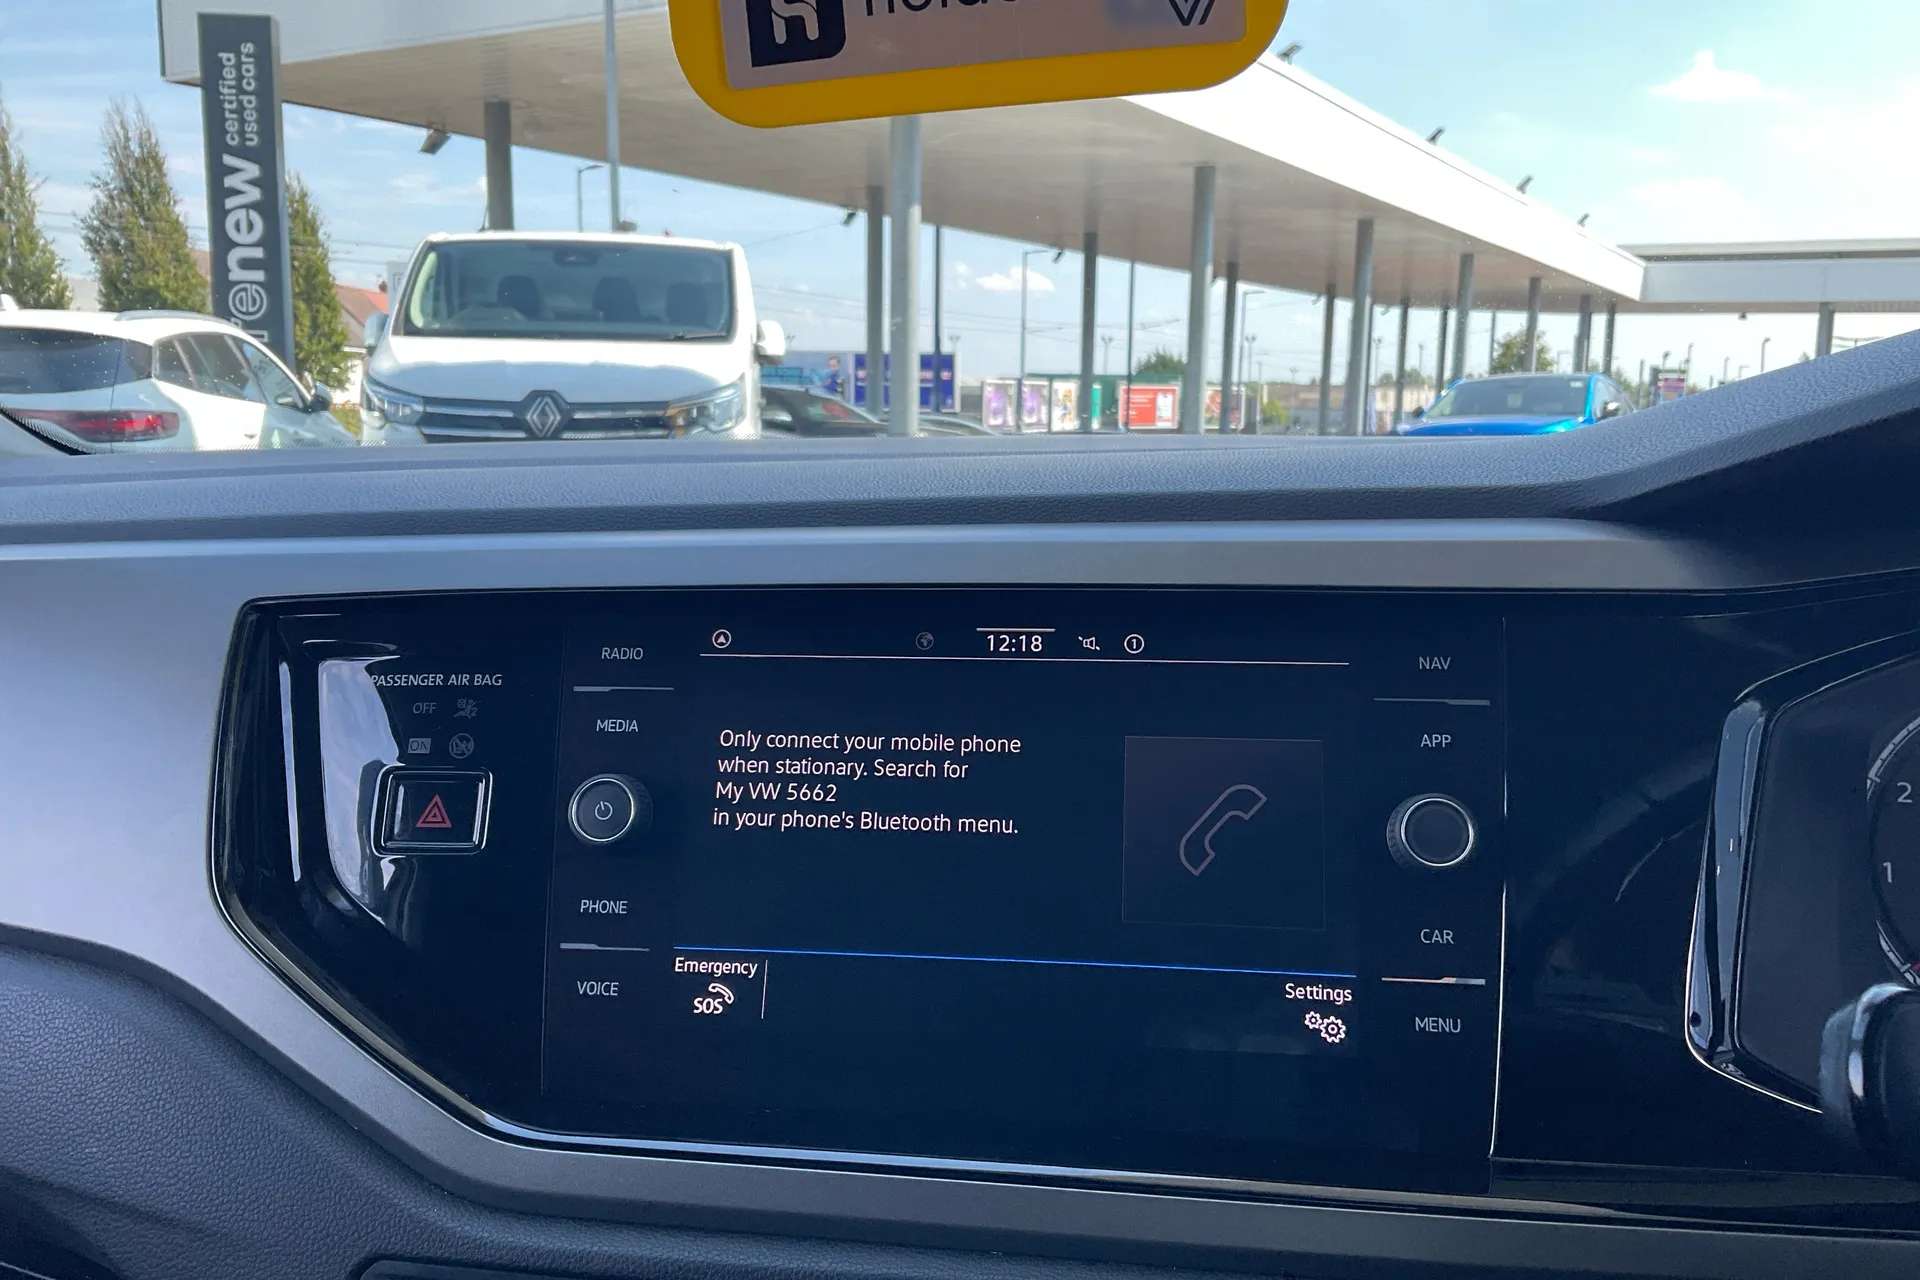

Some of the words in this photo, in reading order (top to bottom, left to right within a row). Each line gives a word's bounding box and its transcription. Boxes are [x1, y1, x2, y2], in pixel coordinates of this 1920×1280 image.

[240, 41, 256, 92] cars
[218, 52, 239, 146] certified
[239, 94, 259, 147] used
[986, 634, 1043, 652] 12:18
[600, 646, 645, 661] RADIO
[1418, 656, 1451, 670] NAV
[370, 674, 444, 687] PASSENGER
[448, 673, 470, 686] AIR
[473, 673, 503, 686] BAG
[412, 702, 437, 714] OFF
[595, 718, 640, 734] MEDIA
[409, 739, 430, 753] ON
[719, 729, 761, 752] Only
[766, 733, 839, 750] connect
[843, 735, 885, 754] your
[891, 733, 955, 752] mobile
[960, 734, 1022, 756] phone
[1420, 733, 1452, 748] APP
[718, 756, 769, 774] when
[775, 757, 868, 780] stationary.
[873, 759, 937, 778] Search
[943, 760, 969, 778] for
[716, 781, 744, 804] My
[749, 782, 781, 801] VW
[786, 783, 838, 802] 5662
[1896, 781, 1913, 803] 2
[712, 807, 729, 826] in
[734, 811, 777, 831] your
[780, 810, 854, 832] phone's
[860, 811, 951, 833] Bluetooth
[957, 815, 1019, 834] menu.
[1882, 861, 1893, 883] 1
[579, 898, 629, 915] PHONE
[1420, 928, 1454, 945] CAR
[674, 956, 758, 979] Emergency
[577, 979, 620, 997] VOICE
[1284, 981, 1353, 1005] Settings
[693, 997, 724, 1015] SOS
[1415, 1016, 1462, 1033] MENU
